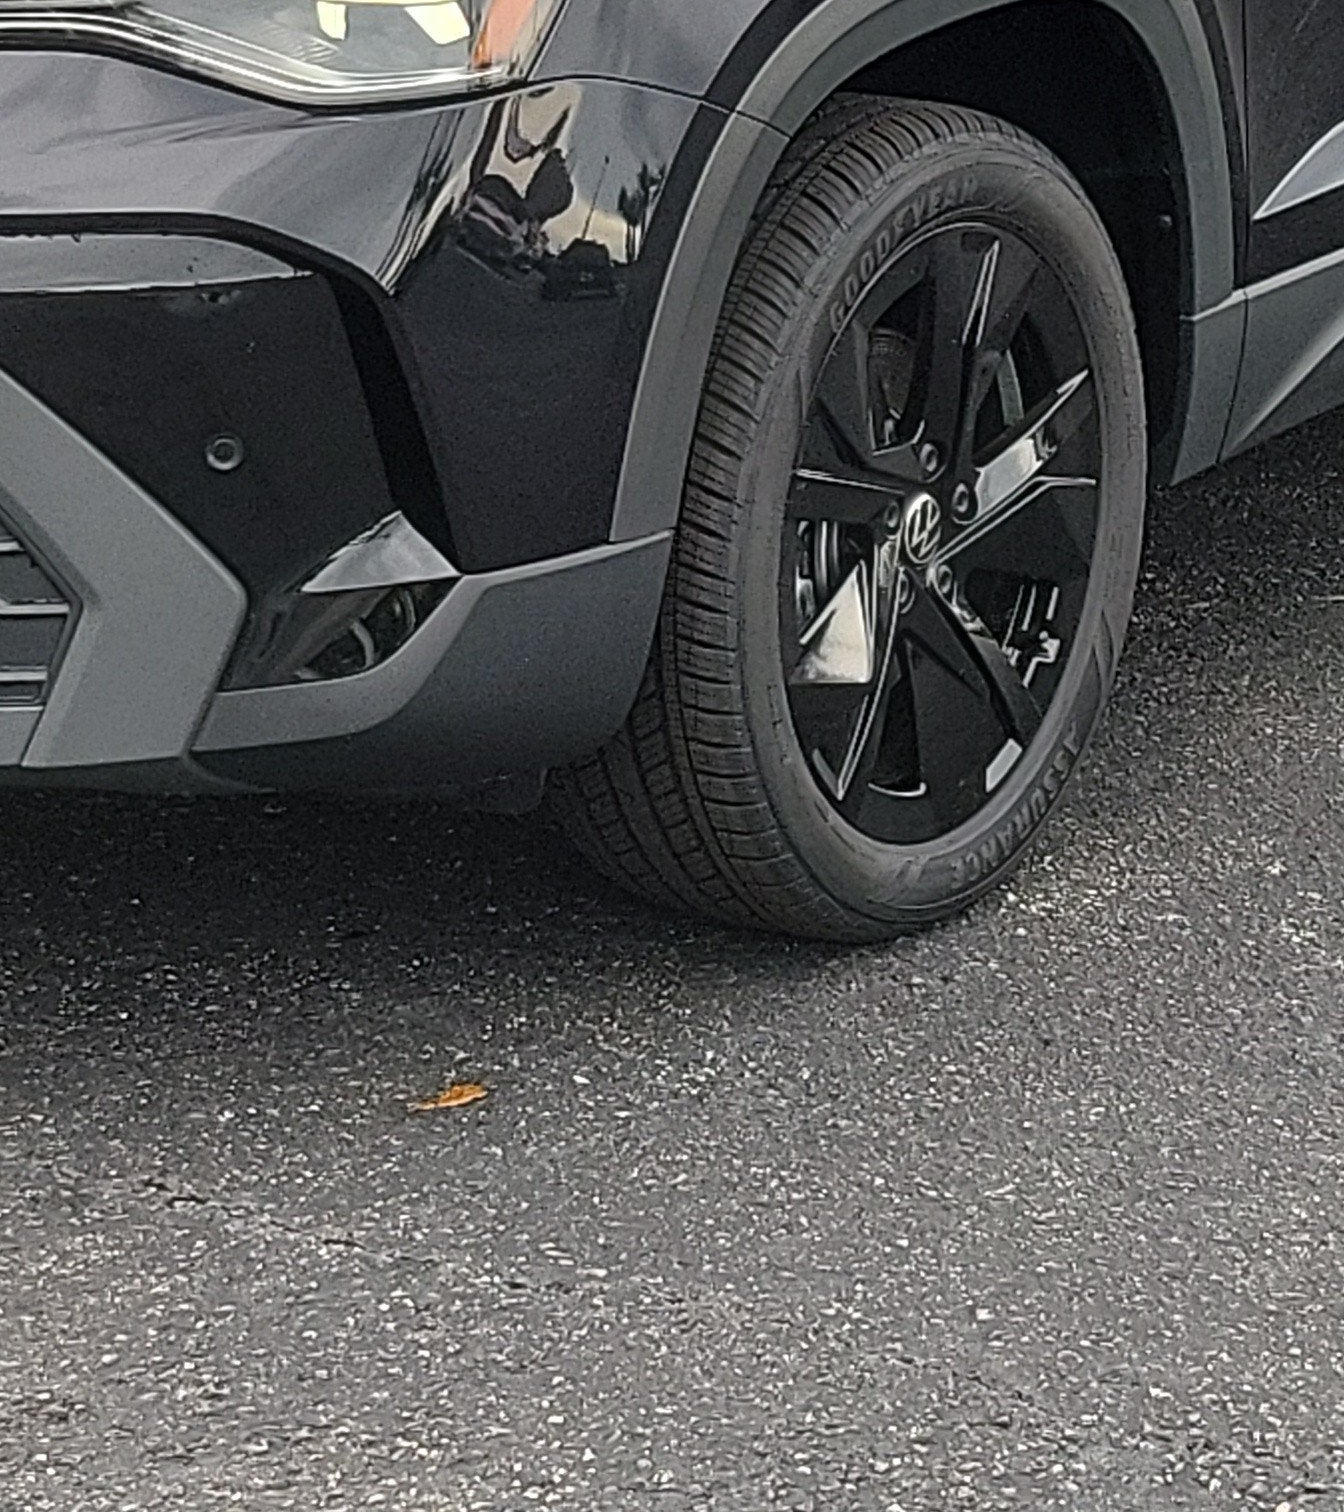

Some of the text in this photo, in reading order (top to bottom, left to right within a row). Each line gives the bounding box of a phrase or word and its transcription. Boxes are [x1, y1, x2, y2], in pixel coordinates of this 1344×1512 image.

[829, 175, 978, 334] GOODYEAR
[905, 494, 942, 563] VW
[949, 720, 1079, 888] ASSURANCE
